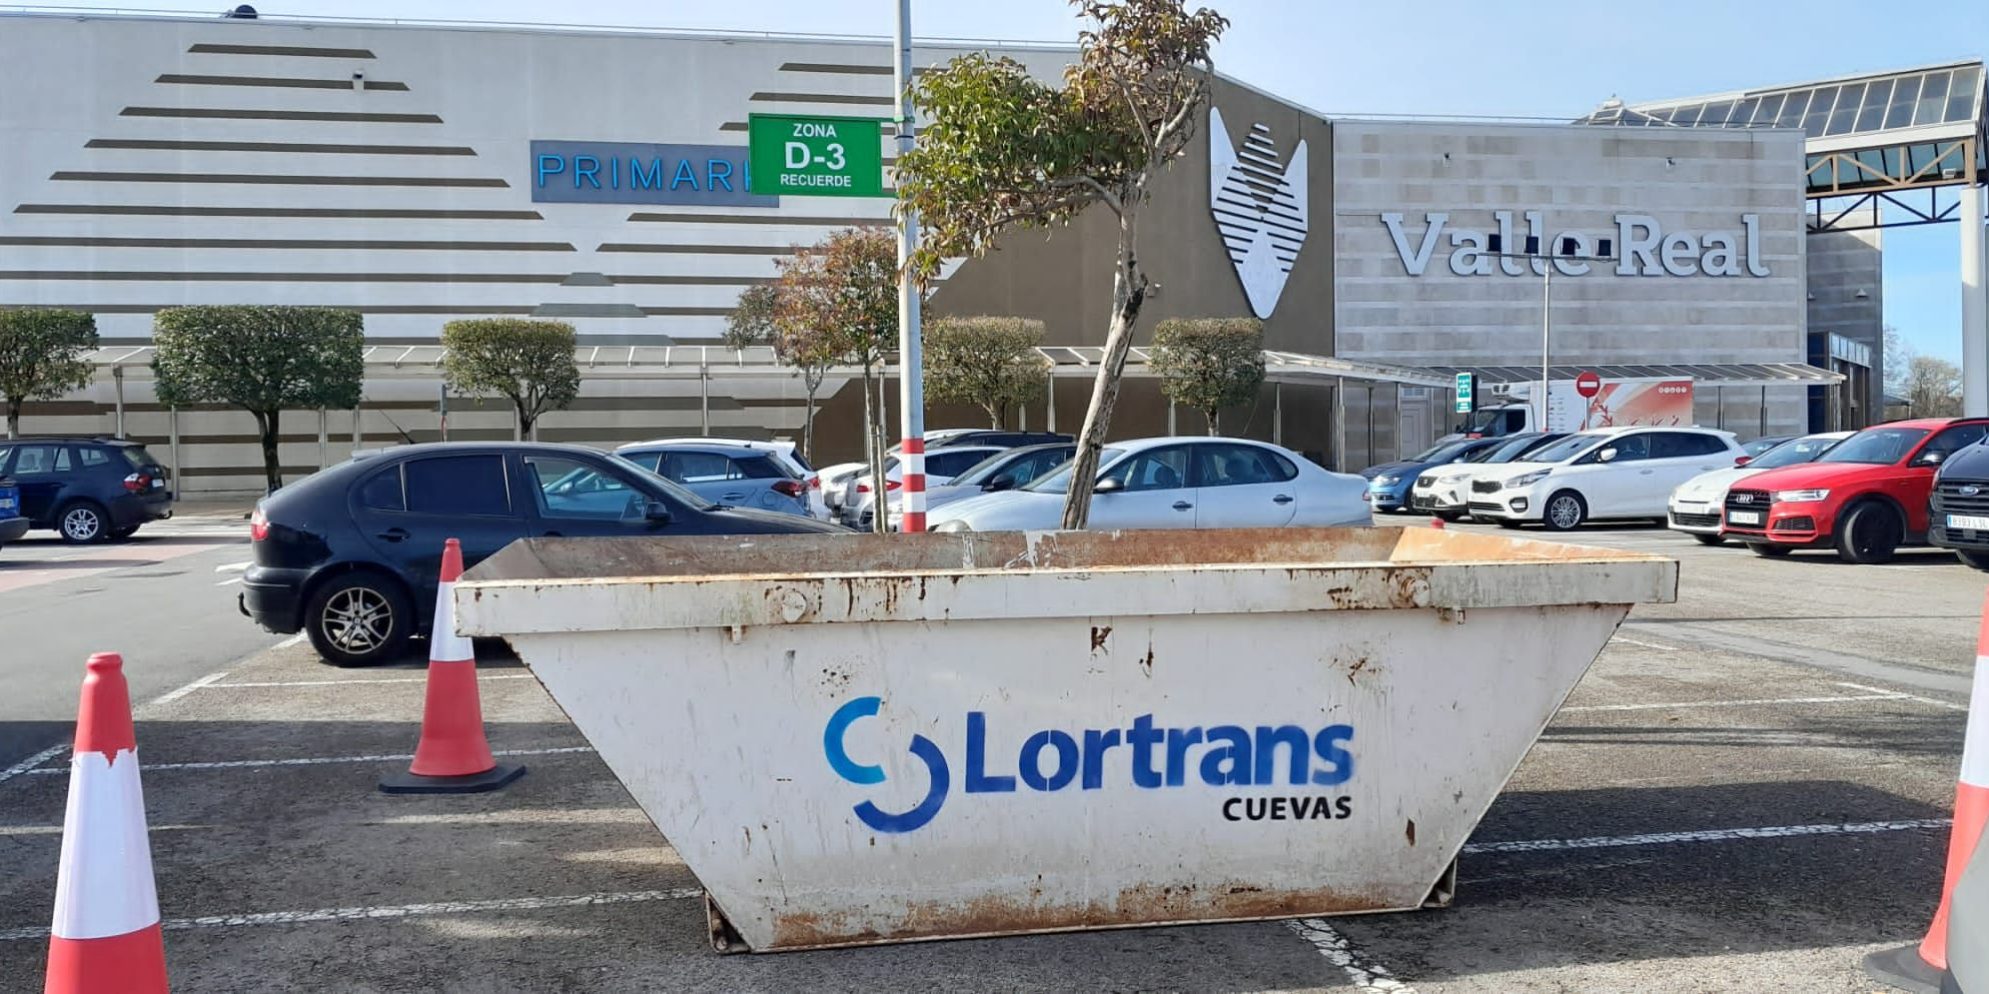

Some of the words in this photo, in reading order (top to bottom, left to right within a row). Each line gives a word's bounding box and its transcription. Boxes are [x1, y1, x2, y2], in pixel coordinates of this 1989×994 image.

[793, 123, 837, 138] ZONA
[785, 141, 846, 170] D-3
[780, 173, 852, 187] RECUERDE
[1381, 210, 1591, 276] Valle
[1614, 213, 1771, 277] Real
[966, 711, 1354, 793] Lortrans
[1222, 796, 1352, 822] CUEVAS
